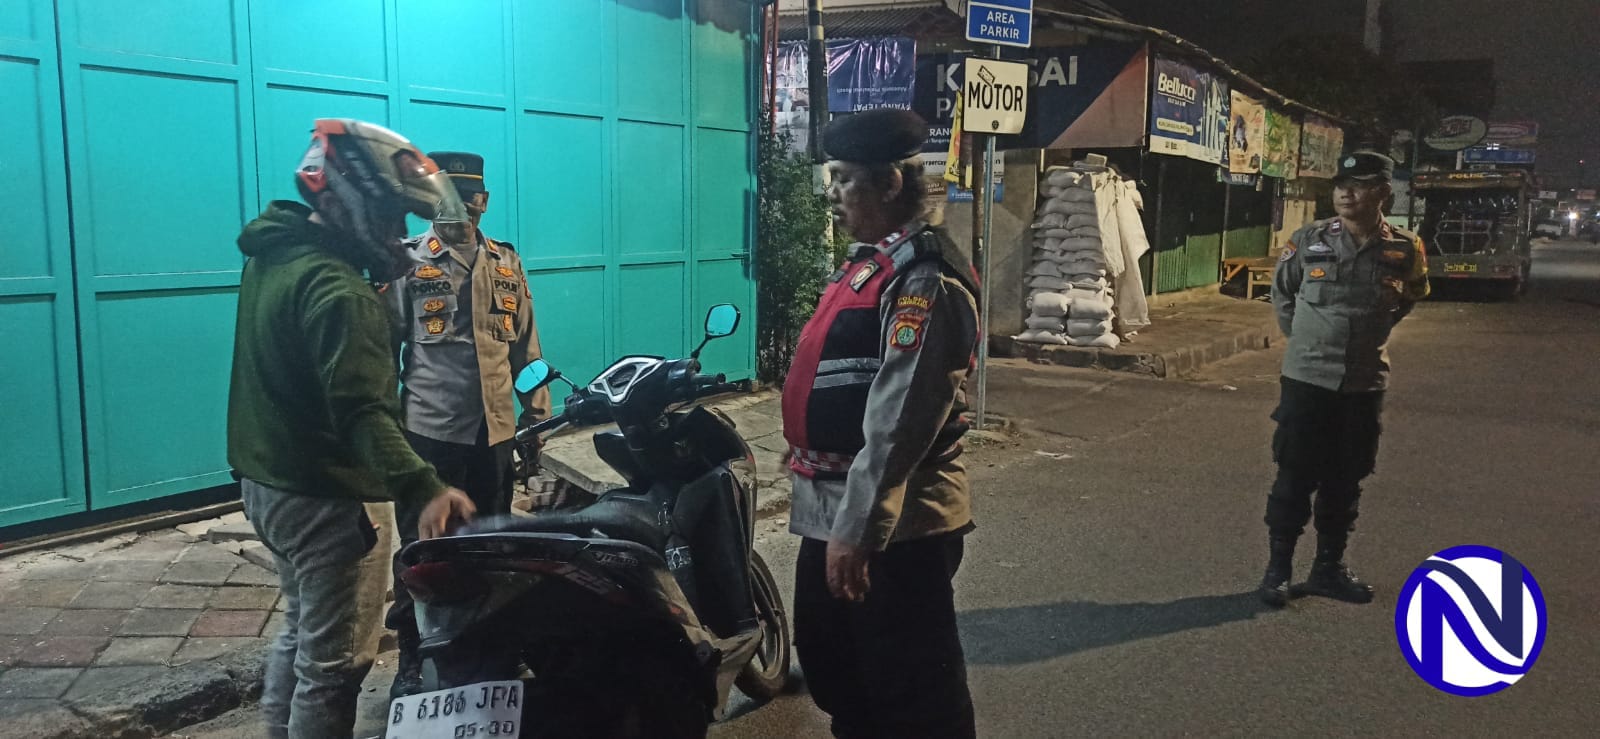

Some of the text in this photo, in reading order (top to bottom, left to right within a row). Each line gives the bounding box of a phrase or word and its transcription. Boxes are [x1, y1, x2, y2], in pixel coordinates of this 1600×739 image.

[986, 10, 1015, 25] AREA
[980, 24, 1020, 40] PARKIR
[967, 81, 1024, 112] MOTOR
[1157, 73, 1196, 100] Bellucci
[391, 685, 520, 725] B 6186 JPA
